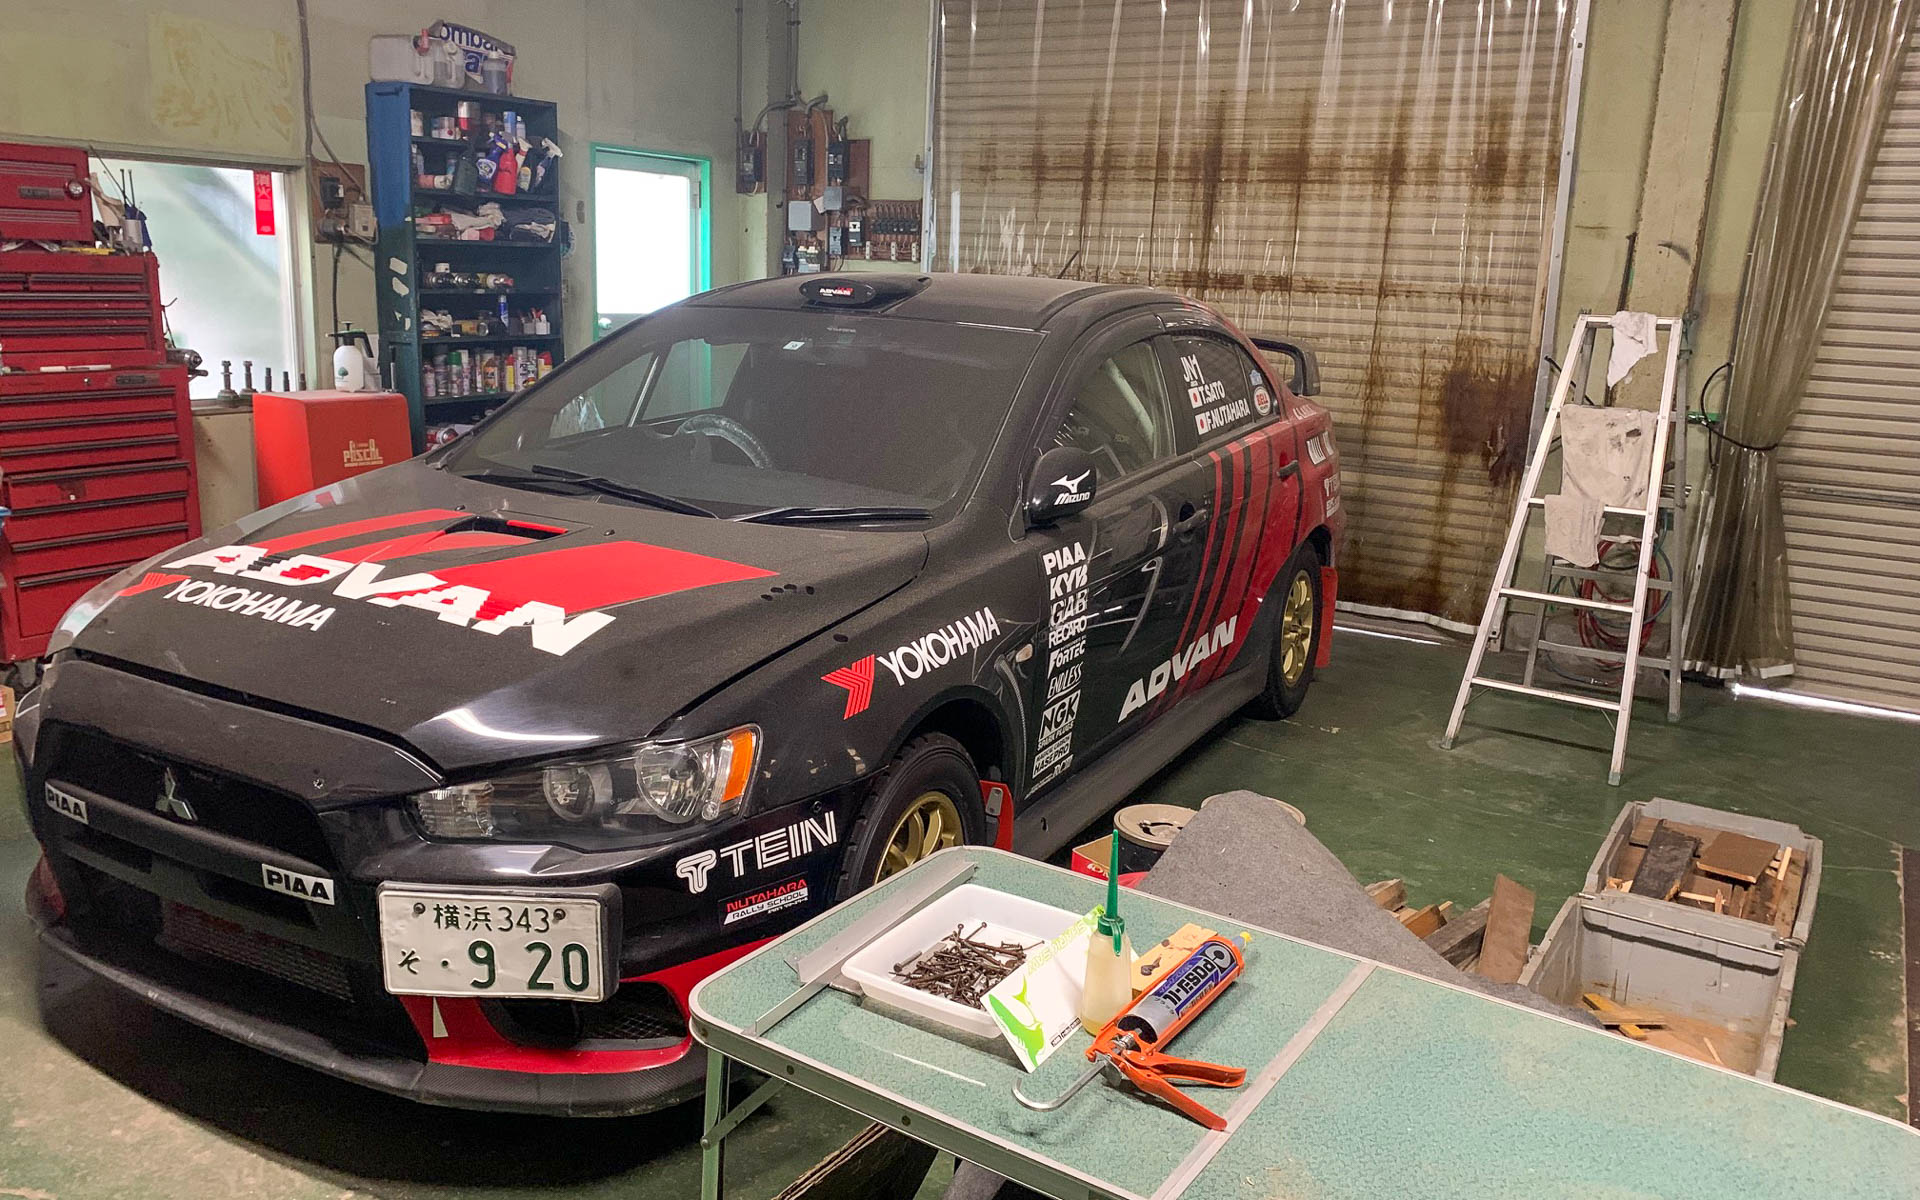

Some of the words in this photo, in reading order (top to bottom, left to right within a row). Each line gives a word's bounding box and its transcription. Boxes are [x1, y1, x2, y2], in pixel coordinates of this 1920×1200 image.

[820, 287, 852, 296] ADVAN
[1042, 541, 1087, 576] PIAA
[161, 545, 617, 657] ADVAN
[1049, 564, 1088, 601] KYB
[163, 578, 337, 632] YOKOHAMA
[876, 606, 1001, 687] YOKOHAMA
[1048, 615, 1088, 649] RECARO
[1046, 660, 1084, 700] ENDLESS
[1117, 615, 1238, 724] ADVAN
[1040, 691, 1080, 740] NGK
[45, 787, 86, 819] PIAA
[719, 810, 838, 878] TEIN
[266, 869, 331, 901] PIAA
[726, 878, 807, 913] NUTAHARA
[732, 903, 764, 920] RALLY
[766, 891, 805, 908] SCHOOL
